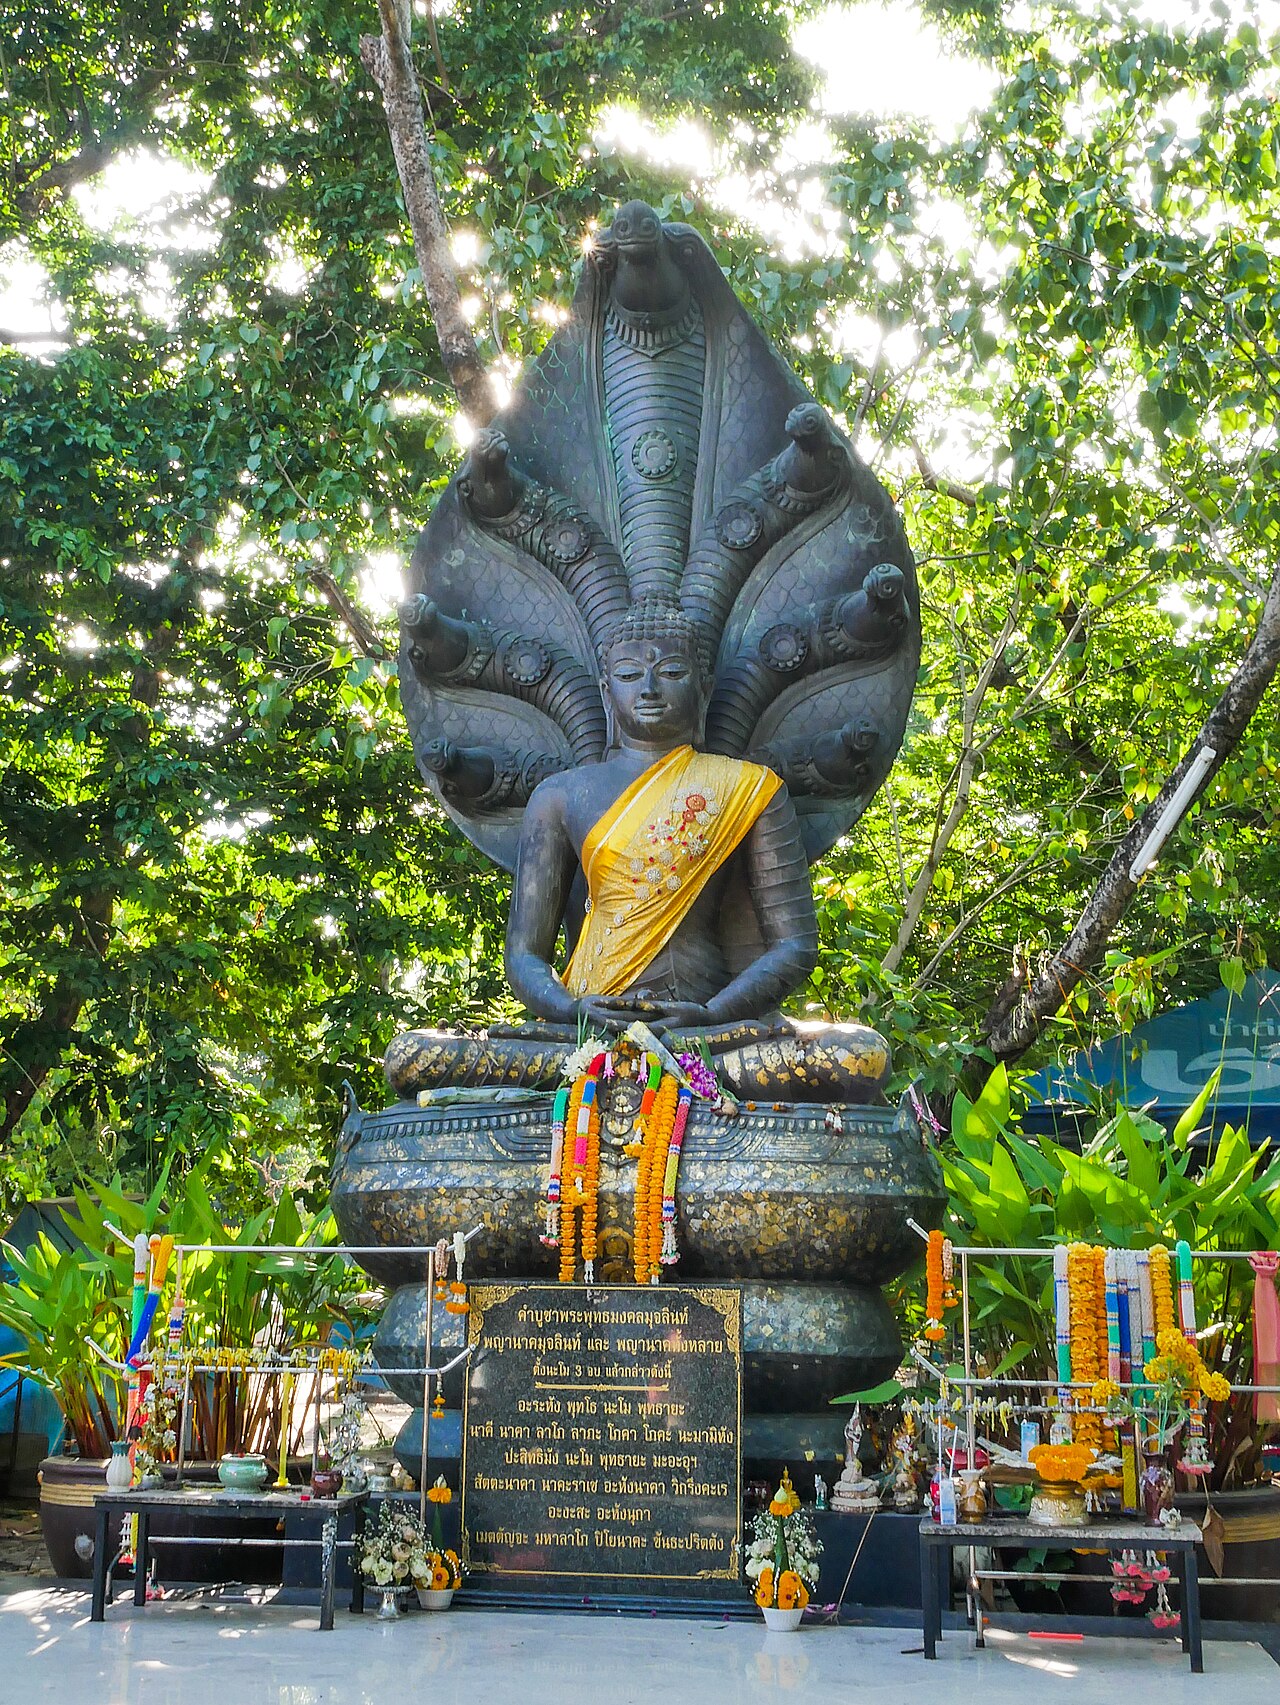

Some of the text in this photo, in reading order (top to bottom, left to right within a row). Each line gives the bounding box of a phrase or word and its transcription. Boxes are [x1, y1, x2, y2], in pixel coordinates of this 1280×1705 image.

[483, 1332, 581, 1355] พญานาคมุจลินท์
[587, 1336, 610, 1352] และ
[532, 1355, 570, 1378] ตั้งนะโม
[574, 1365, 583, 1378] 3
[588, 1366, 601, 1378] จบ
[517, 1396, 686, 1420] อะระหัง พุทโธ นะโม พุทธายะ
[469, 1420, 494, 1438] นาคี
[499, 1423, 531, 1438] นาคา
[565, 1448, 593, 1466] นะโม
[599, 1452, 647, 1472] พุทธายะ
